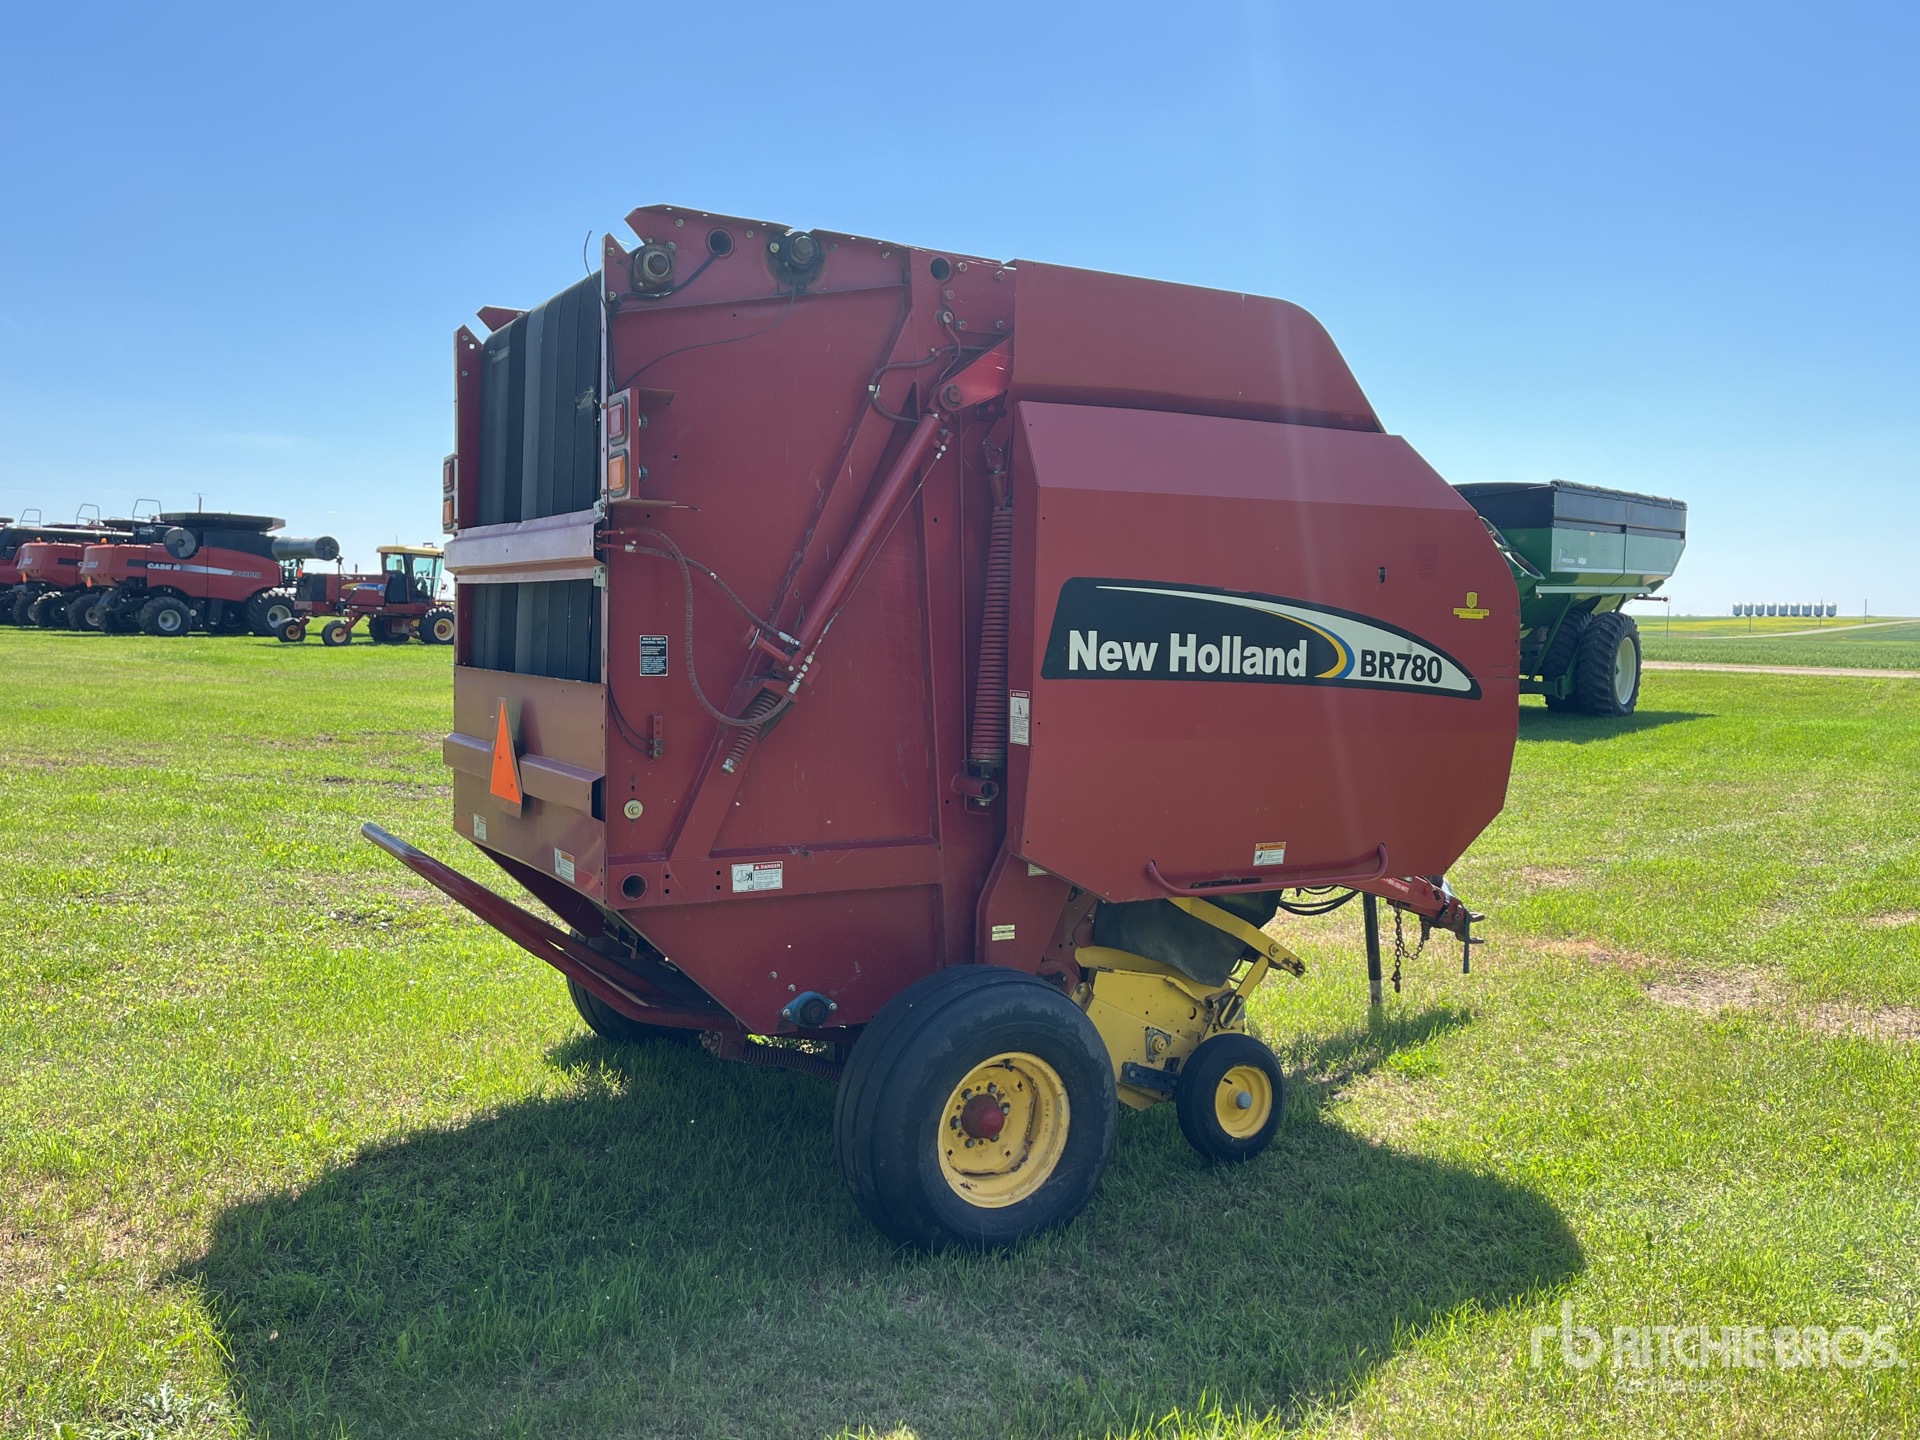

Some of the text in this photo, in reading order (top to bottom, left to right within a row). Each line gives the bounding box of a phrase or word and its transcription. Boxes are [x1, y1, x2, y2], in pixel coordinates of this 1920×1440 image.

[147, 562, 172, 571] CASE
[1068, 629, 1442, 684] New Holland BR780
